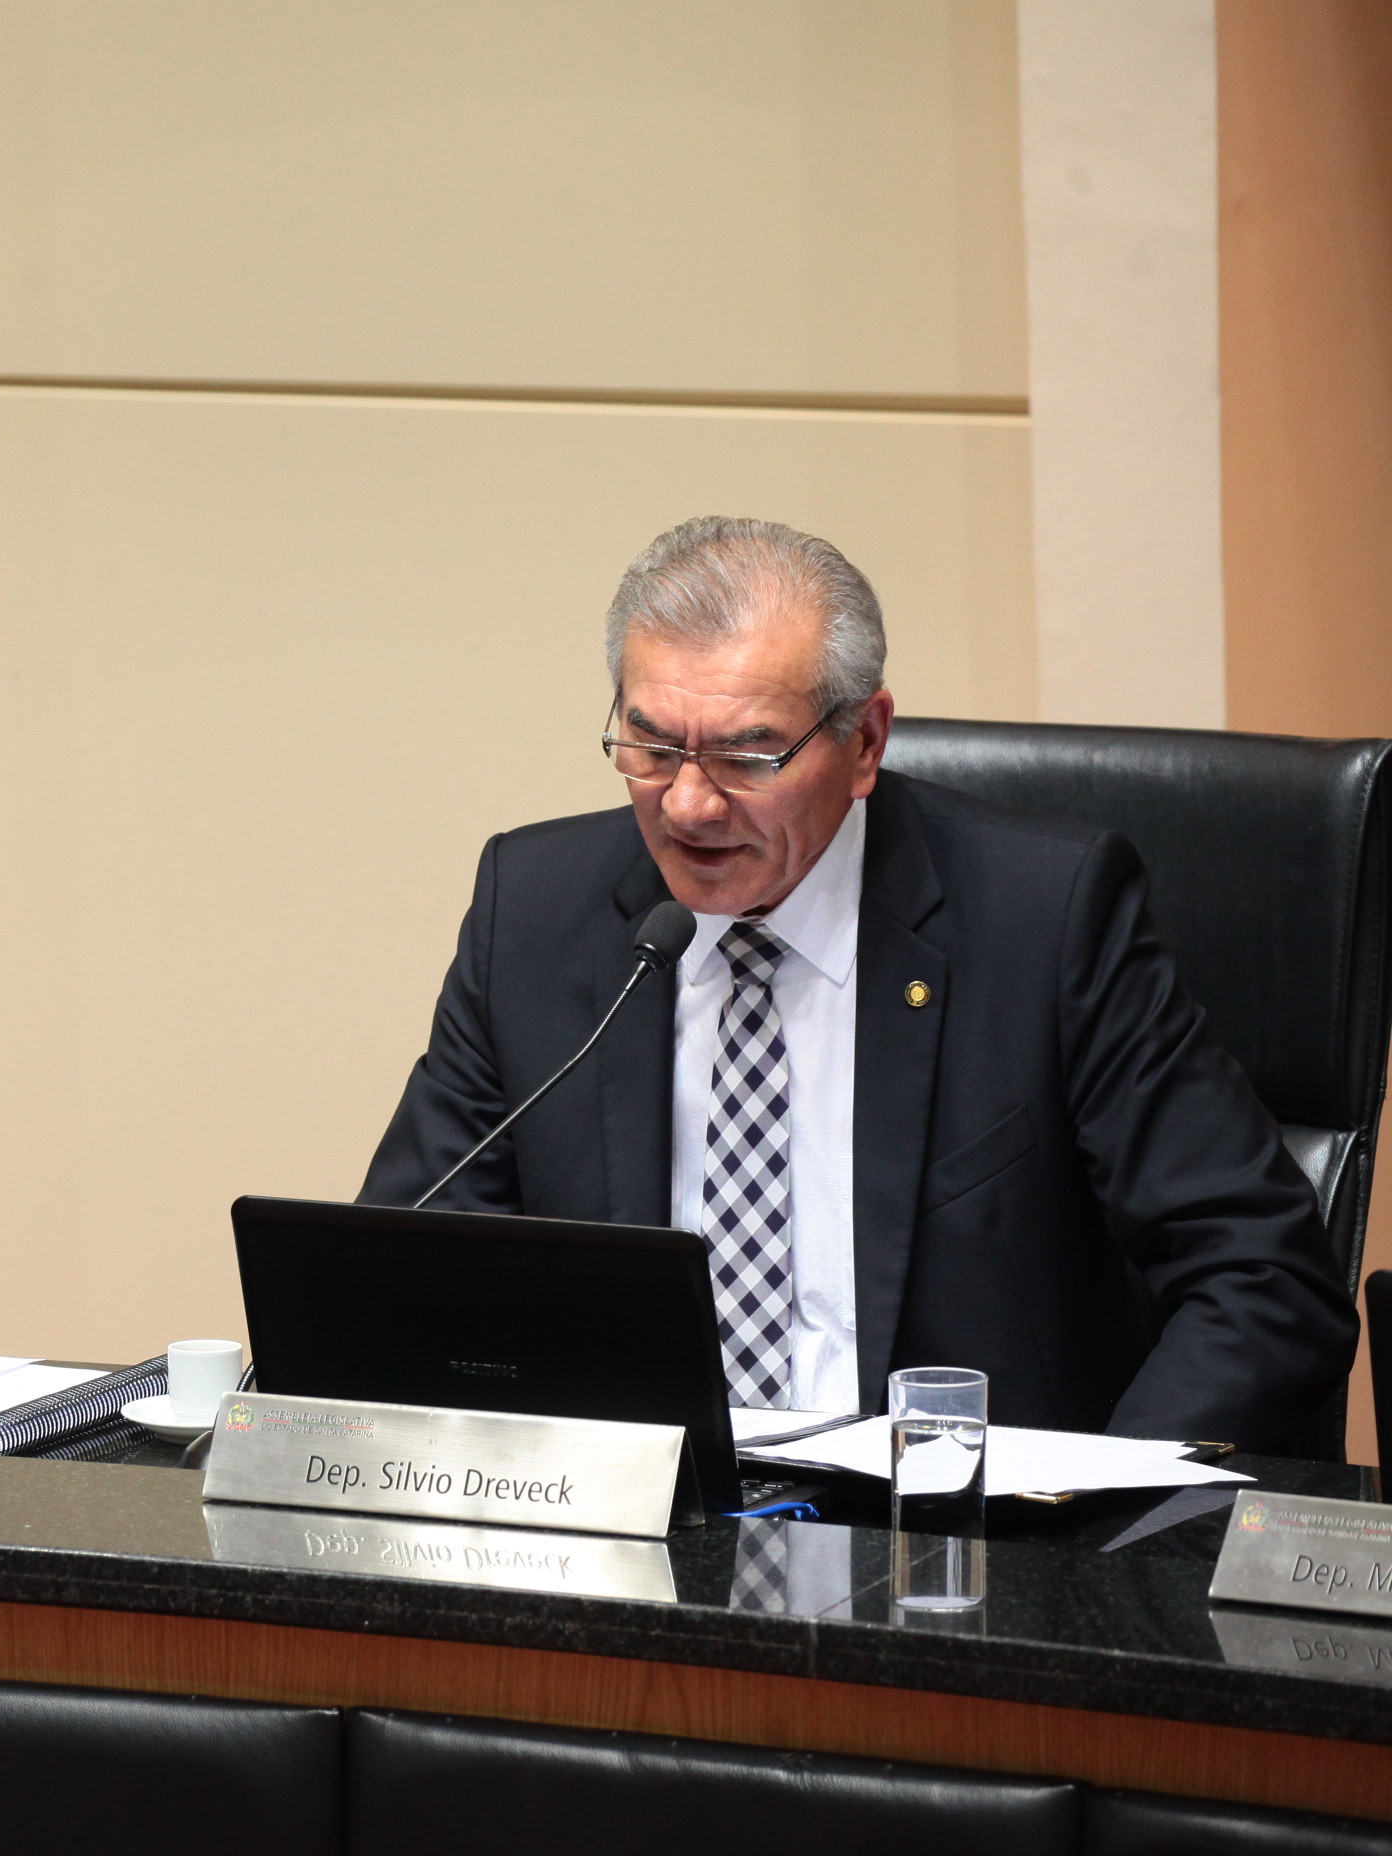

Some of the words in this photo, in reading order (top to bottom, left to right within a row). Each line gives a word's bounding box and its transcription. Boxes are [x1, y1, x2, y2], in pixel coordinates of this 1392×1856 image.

[263, 1410, 317, 1423] ASSEMBLEIA
[318, 1413, 375, 1427] LEGISLATIVA
[273, 1423, 301, 1433] ESTADO
[305, 1455, 367, 1494] Dep.
[379, 1461, 452, 1495] Silvio
[463, 1468, 574, 1506] Dreveck
[1291, 1554, 1354, 1594] Dep.
